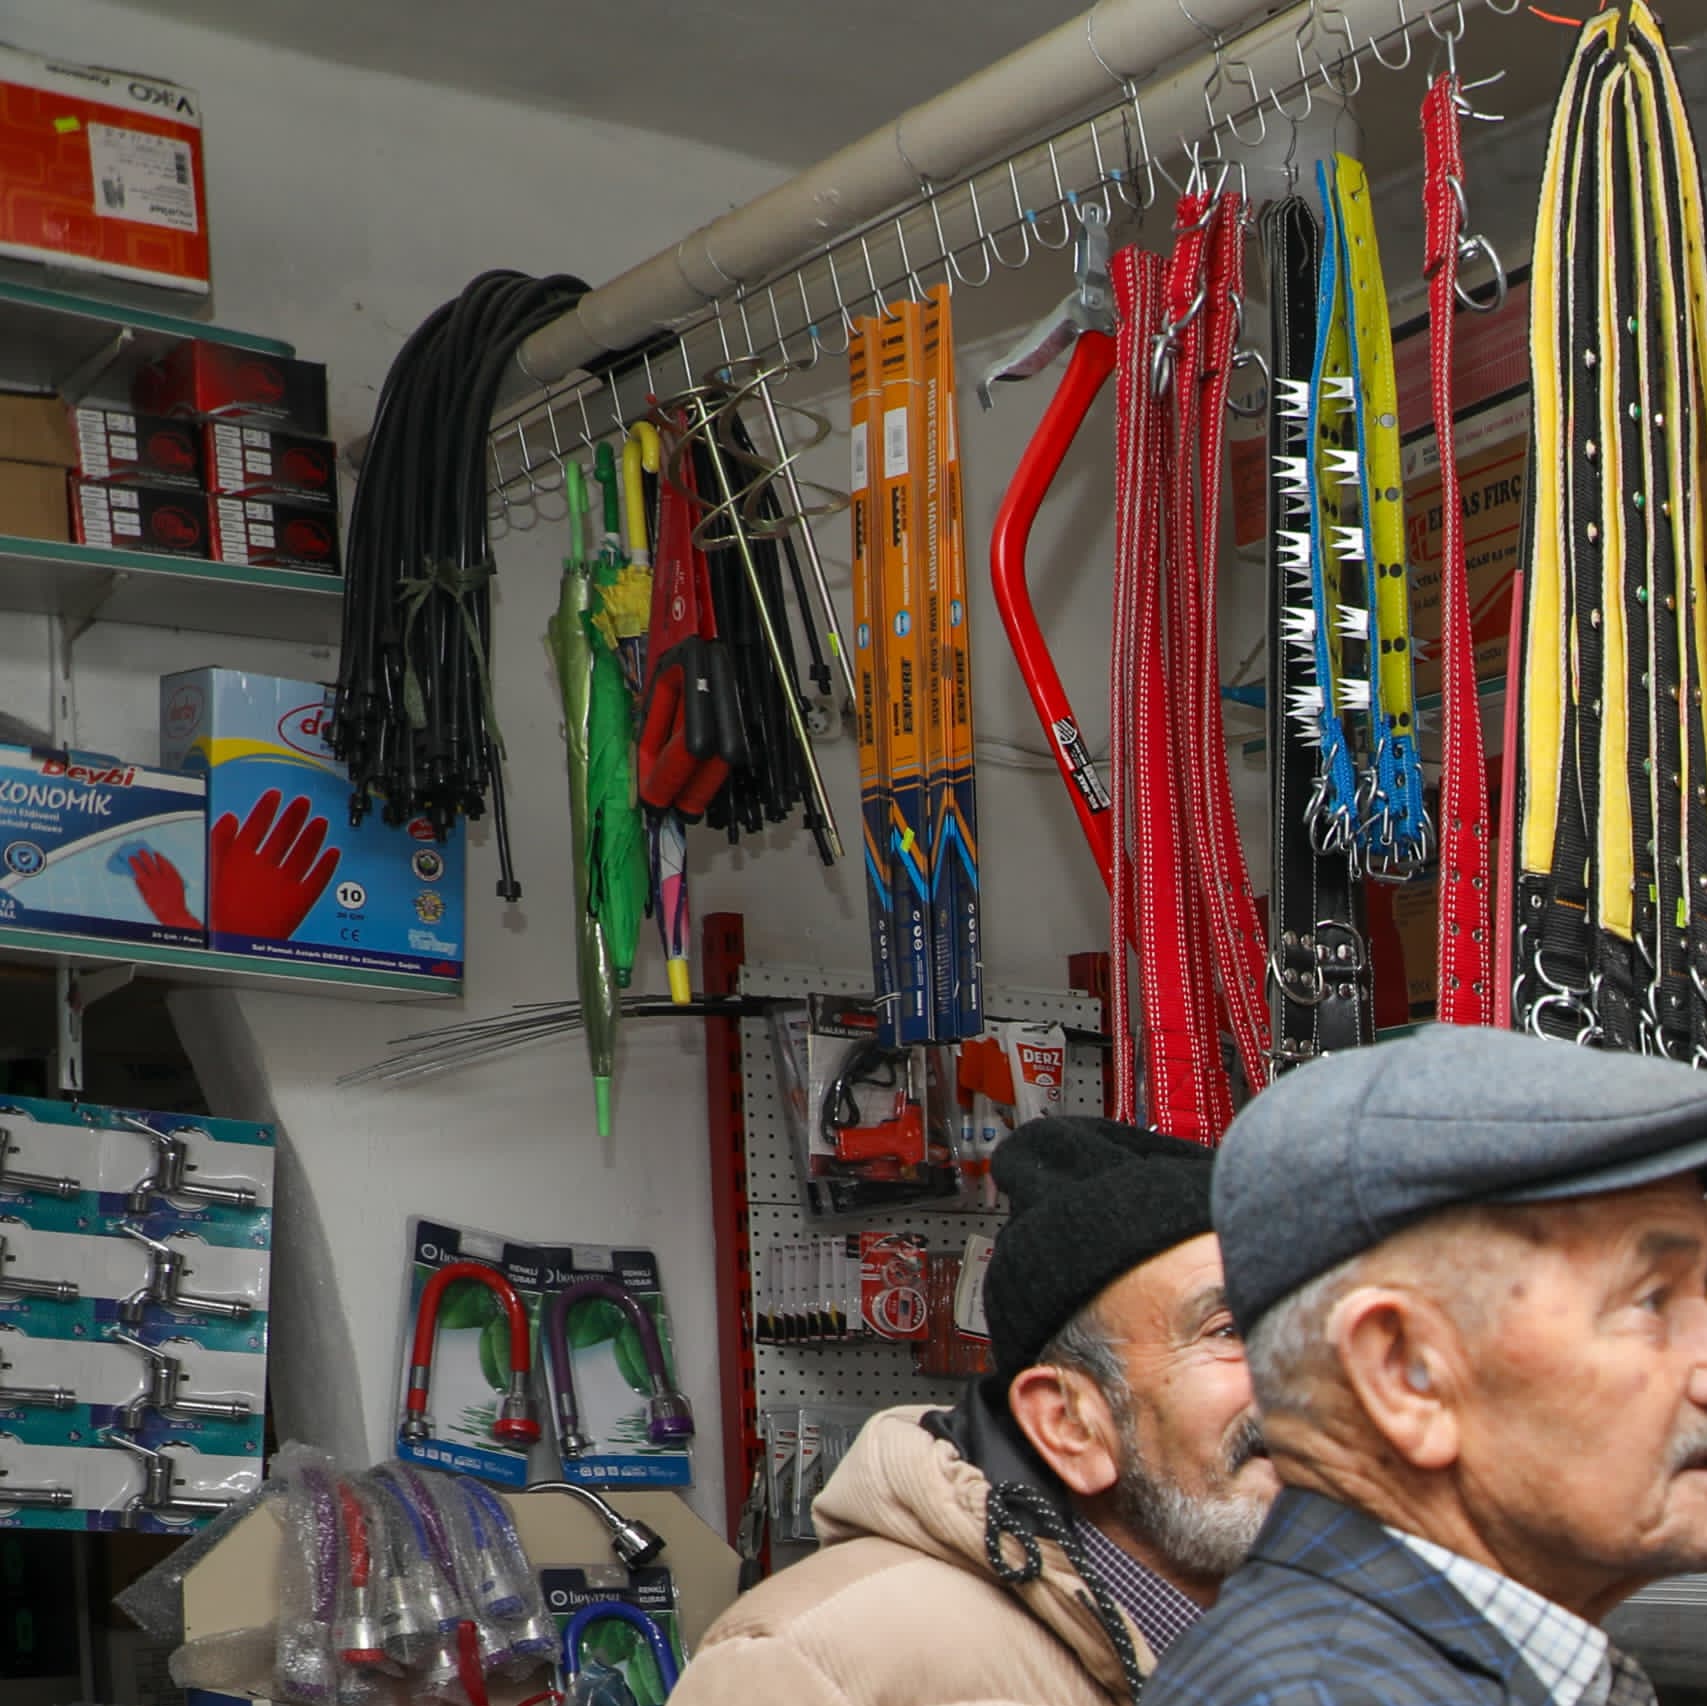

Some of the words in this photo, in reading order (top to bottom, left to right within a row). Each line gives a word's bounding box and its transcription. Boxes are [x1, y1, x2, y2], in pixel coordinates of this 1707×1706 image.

[927, 377, 937, 499] PROFESSIONAL
[927, 499, 938, 593] HARDPOINT
[900, 656, 913, 736] EXPERT
[340, 887, 363, 902] 10
[1023, 1049, 1062, 1066] DERZ
